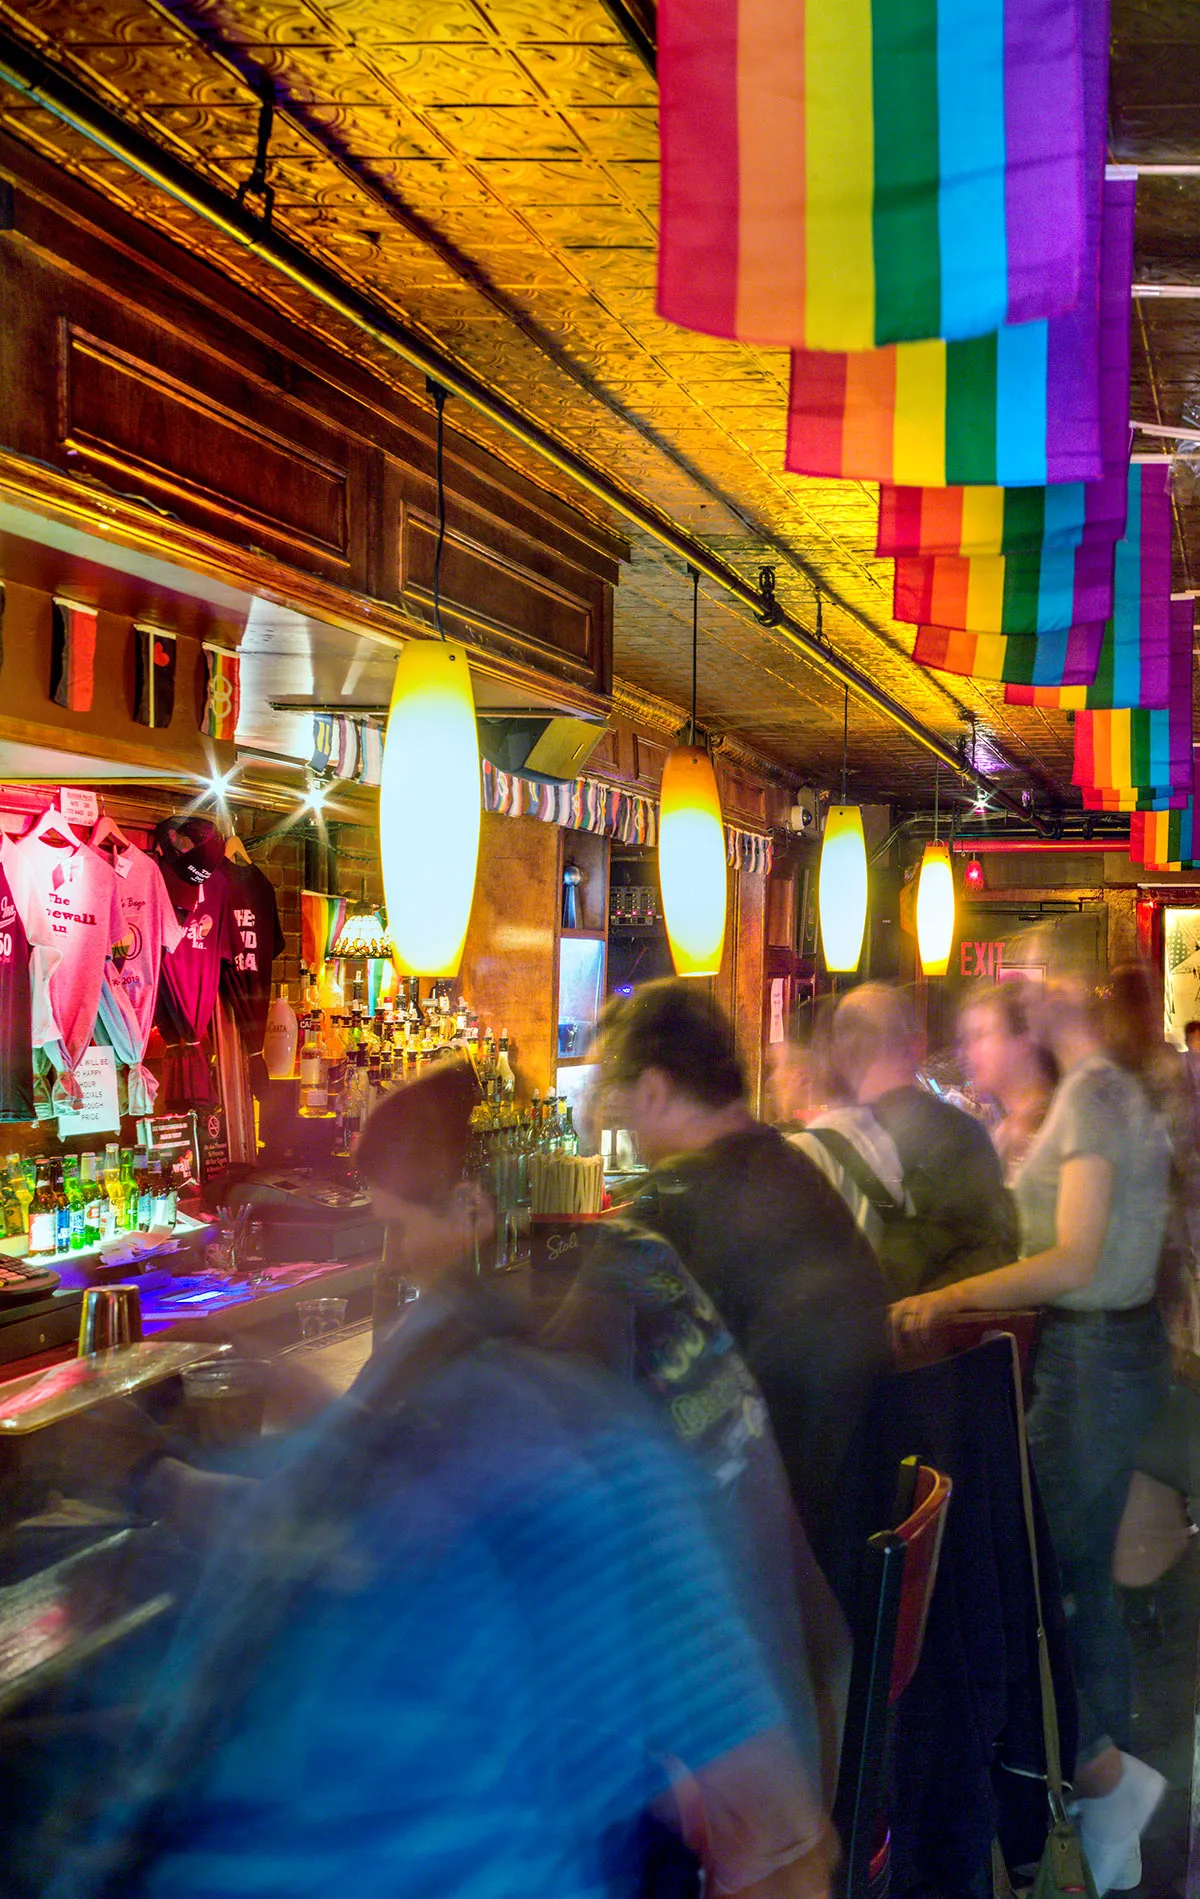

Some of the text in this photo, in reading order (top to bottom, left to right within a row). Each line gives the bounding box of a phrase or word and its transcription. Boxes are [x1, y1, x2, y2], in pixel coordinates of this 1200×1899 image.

[960, 941, 1006, 976] EXIT
[121, 975, 140, 985] 2019
[546, 1231, 580, 1260] Stoli
